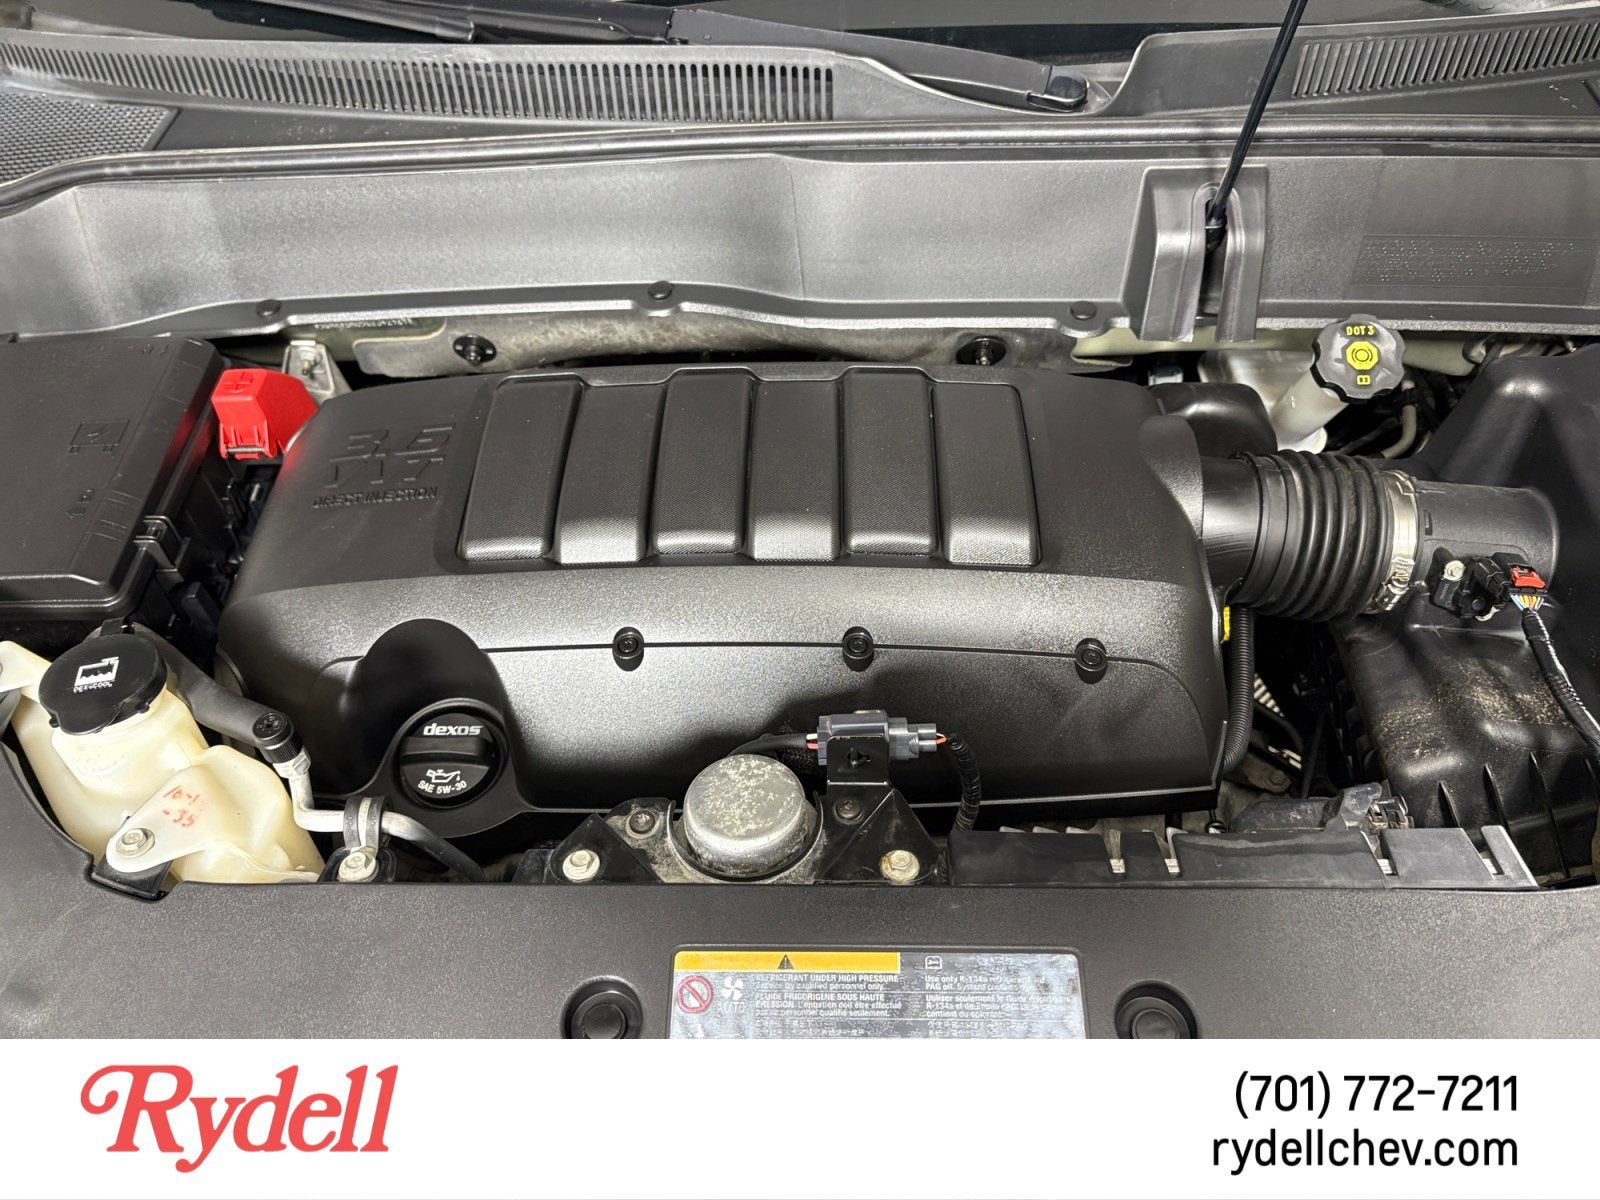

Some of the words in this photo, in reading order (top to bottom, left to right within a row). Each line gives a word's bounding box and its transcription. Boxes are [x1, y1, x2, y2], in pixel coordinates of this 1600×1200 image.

[1346, 326, 1366, 336] DOT
[1367, 326, 1375, 336] 3
[364, 486, 439, 505] INJECTION
[423, 723, 484, 736] dexos
[417, 780, 435, 793] SAE
[436, 780, 467, 794] 5W-30
[810, 974, 837, 983] UNDER
[838, 974, 857, 983] HIGH
[858, 975, 899, 983] PRESSURE
[941, 976, 958, 985] only
[829, 983, 866, 992] personnel
[837, 994, 858, 1002] SOUS
[859, 994, 885, 1002] HAUTE
[849, 1010, 890, 1018] seulement.
